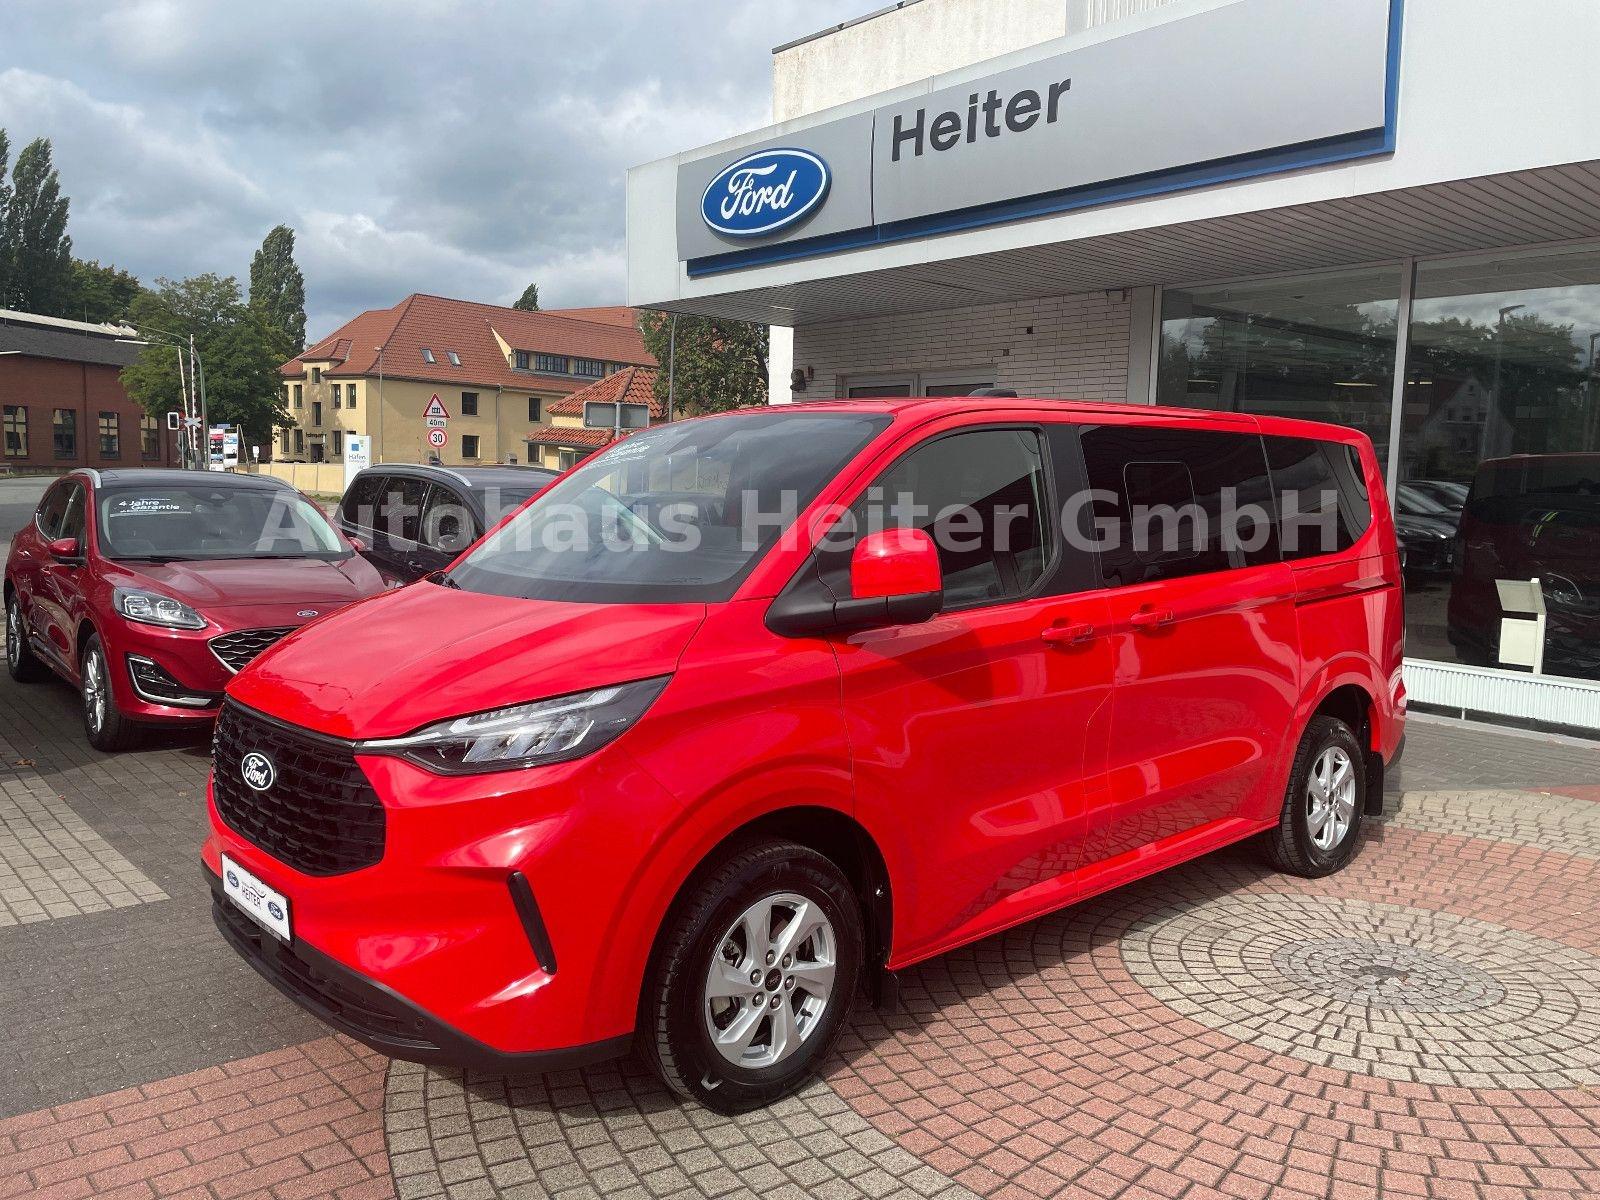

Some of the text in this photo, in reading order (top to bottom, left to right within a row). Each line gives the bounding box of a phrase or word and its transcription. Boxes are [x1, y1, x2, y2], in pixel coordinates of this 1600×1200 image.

[892, 78, 1071, 162] Heiter
[720, 163, 797, 220] Ford
[429, 419, 445, 427] 40m
[432, 433, 443, 443] 30
[245, 756, 268, 786] Ford
